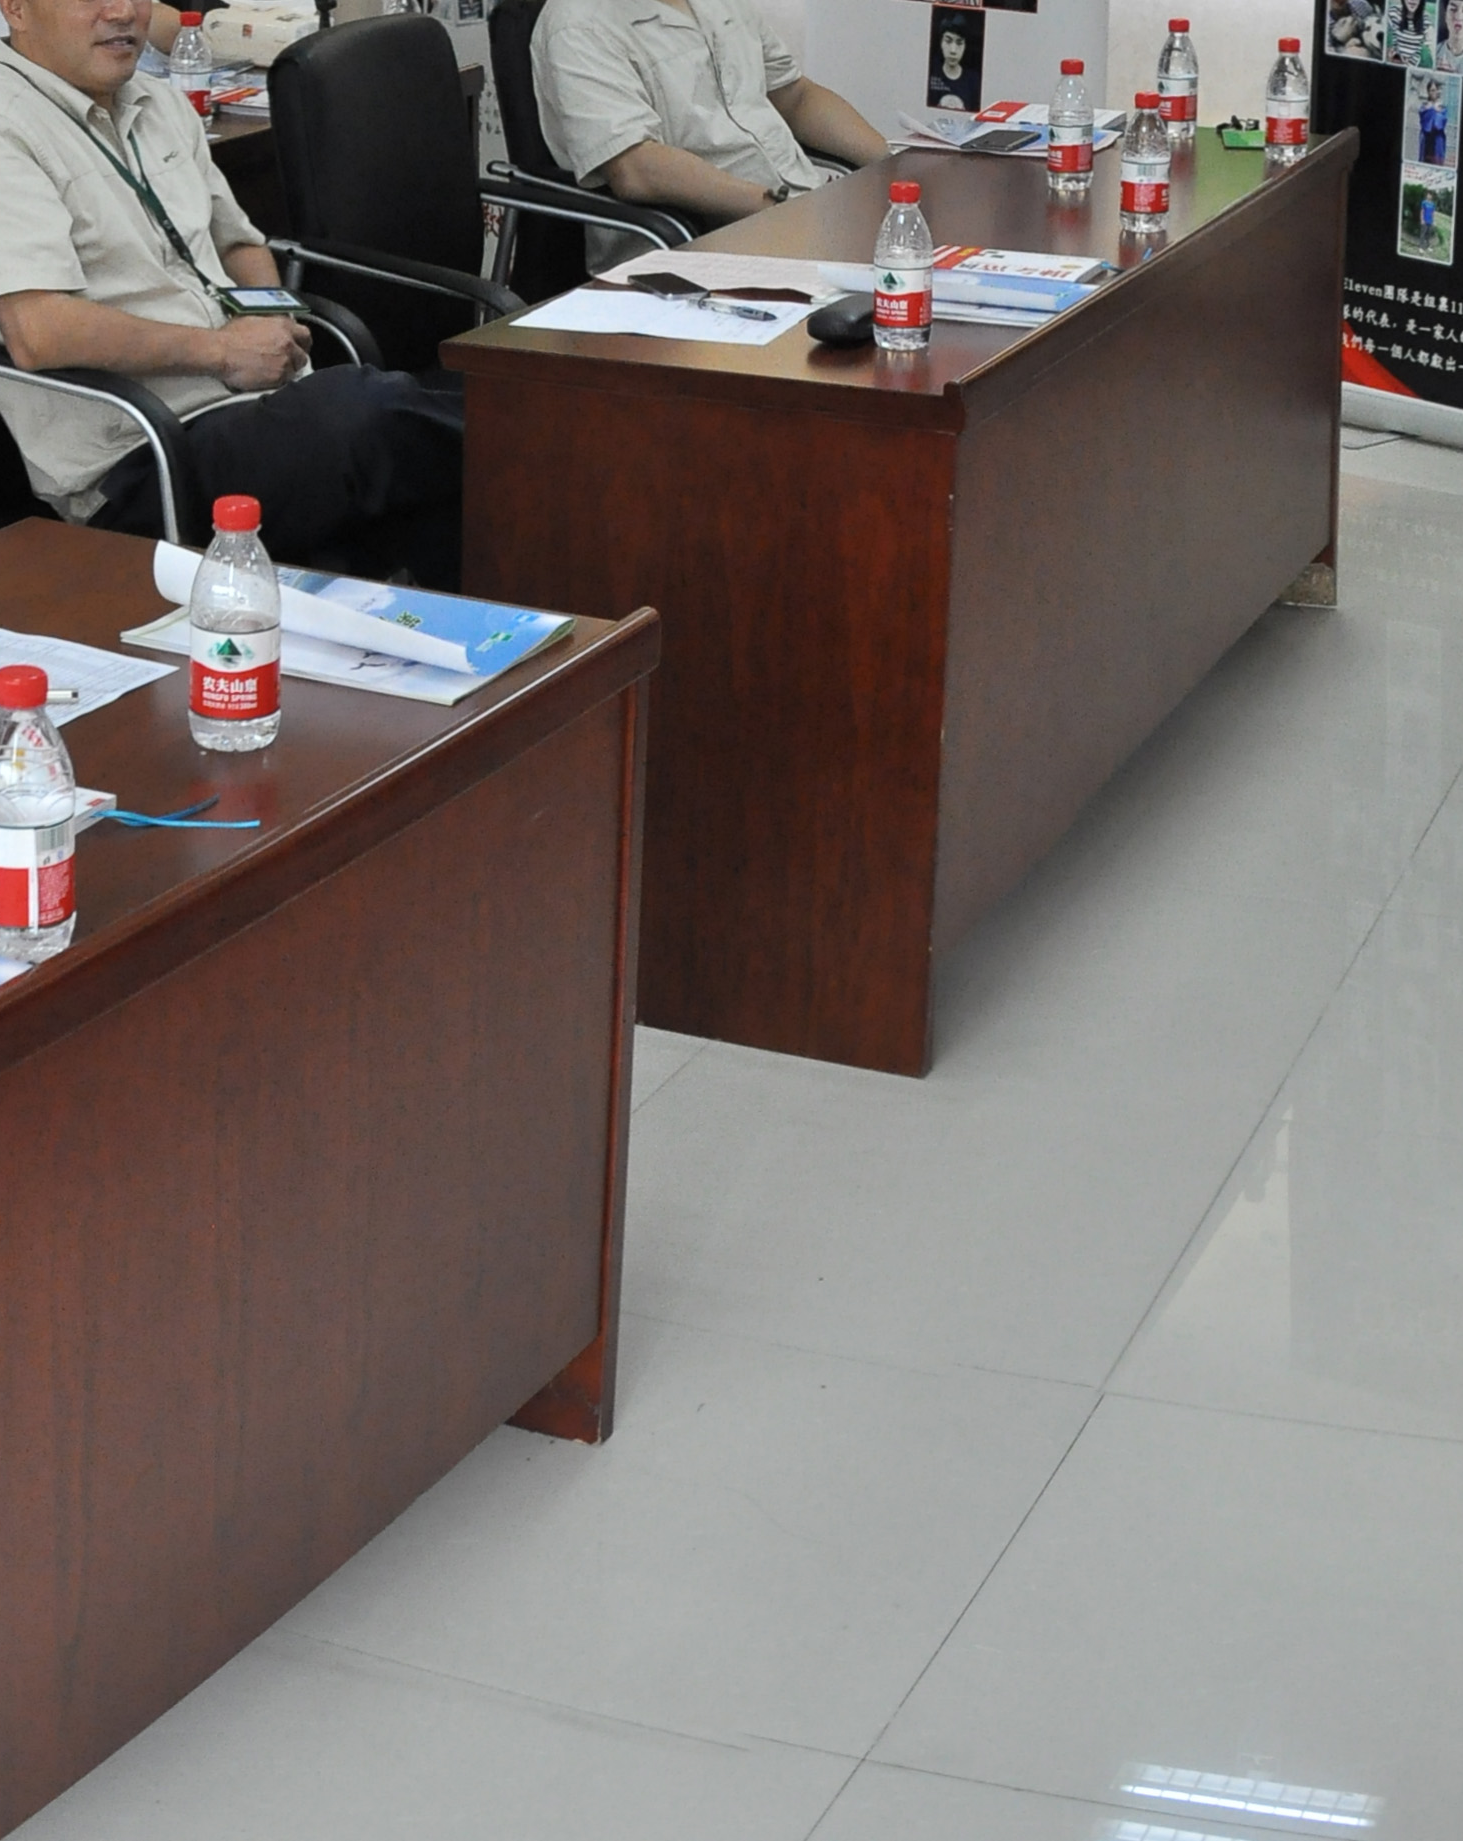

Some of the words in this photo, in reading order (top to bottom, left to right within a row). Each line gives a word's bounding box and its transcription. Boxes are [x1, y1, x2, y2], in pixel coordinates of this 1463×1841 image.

[876, 297, 908, 311] 农夫山泉
[202, 676, 259, 694] 农夫山泉
